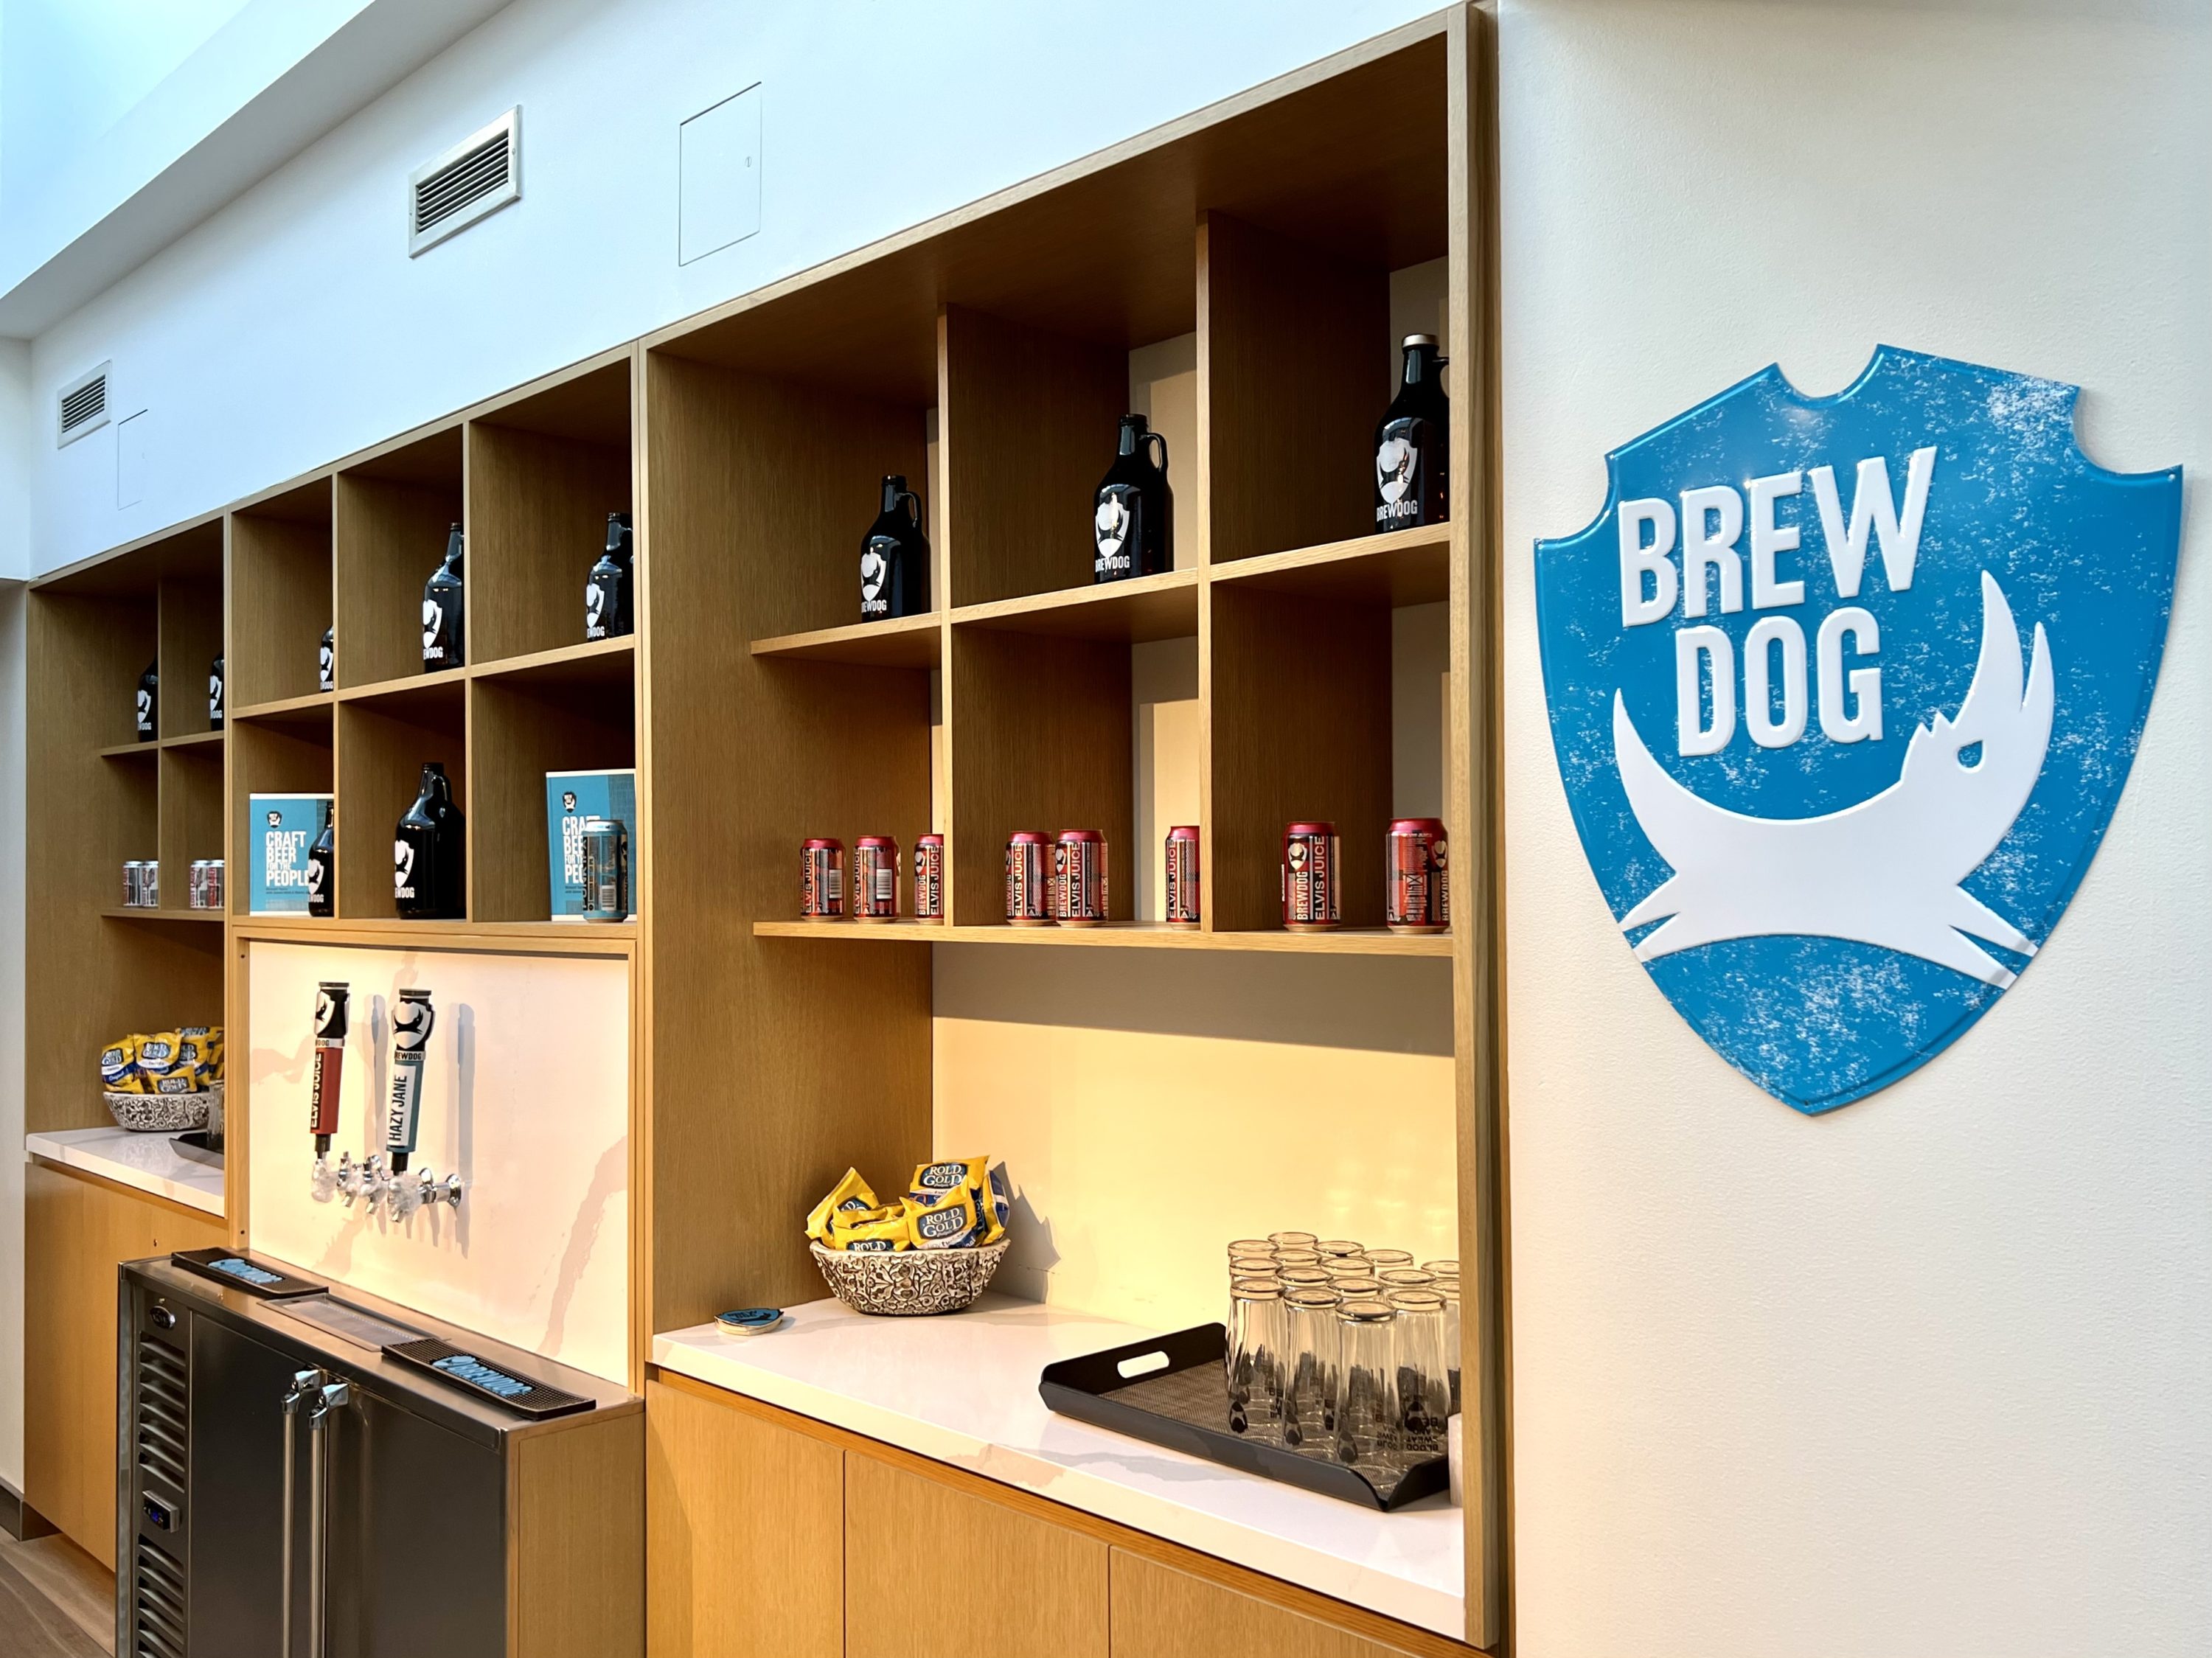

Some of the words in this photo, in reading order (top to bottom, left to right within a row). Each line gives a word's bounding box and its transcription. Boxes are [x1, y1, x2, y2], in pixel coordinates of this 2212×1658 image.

[1618, 446, 1937, 627] BREW
[1675, 607, 1884, 757] DOG
[265, 831, 307, 848] CRAFT
[265, 847, 296, 863] BEER
[563, 835, 583, 855] BEE
[931, 846, 939, 881] JUICE
[1015, 843, 1023, 880] JUICE
[1071, 843, 1081, 880] JUICE
[1315, 836, 1325, 878] JUICE
[931, 882, 939, 915] ELVIS
[1015, 882, 1023, 916] ELVIS
[1059, 874, 1067, 917] BREWDOG
[1071, 882, 1081, 917] ELVIS
[1296, 871, 1308, 920] BREWDOG
[1315, 881, 1325, 920] ELVIS
[313, 1053, 321, 1090] JUICE
[395, 1052, 422, 1060] REWDOG
[392, 1075, 408, 1107] JANE
[310, 1092, 319, 1128] ELVIS
[389, 1109, 404, 1141] HAZY
[923, 1174, 962, 1185] GOLD
[929, 1165, 961, 1175] ROLD
[923, 1216, 964, 1237] GOLD
[925, 1208, 960, 1225] ROLD
[853, 1241, 886, 1251] ROLD
